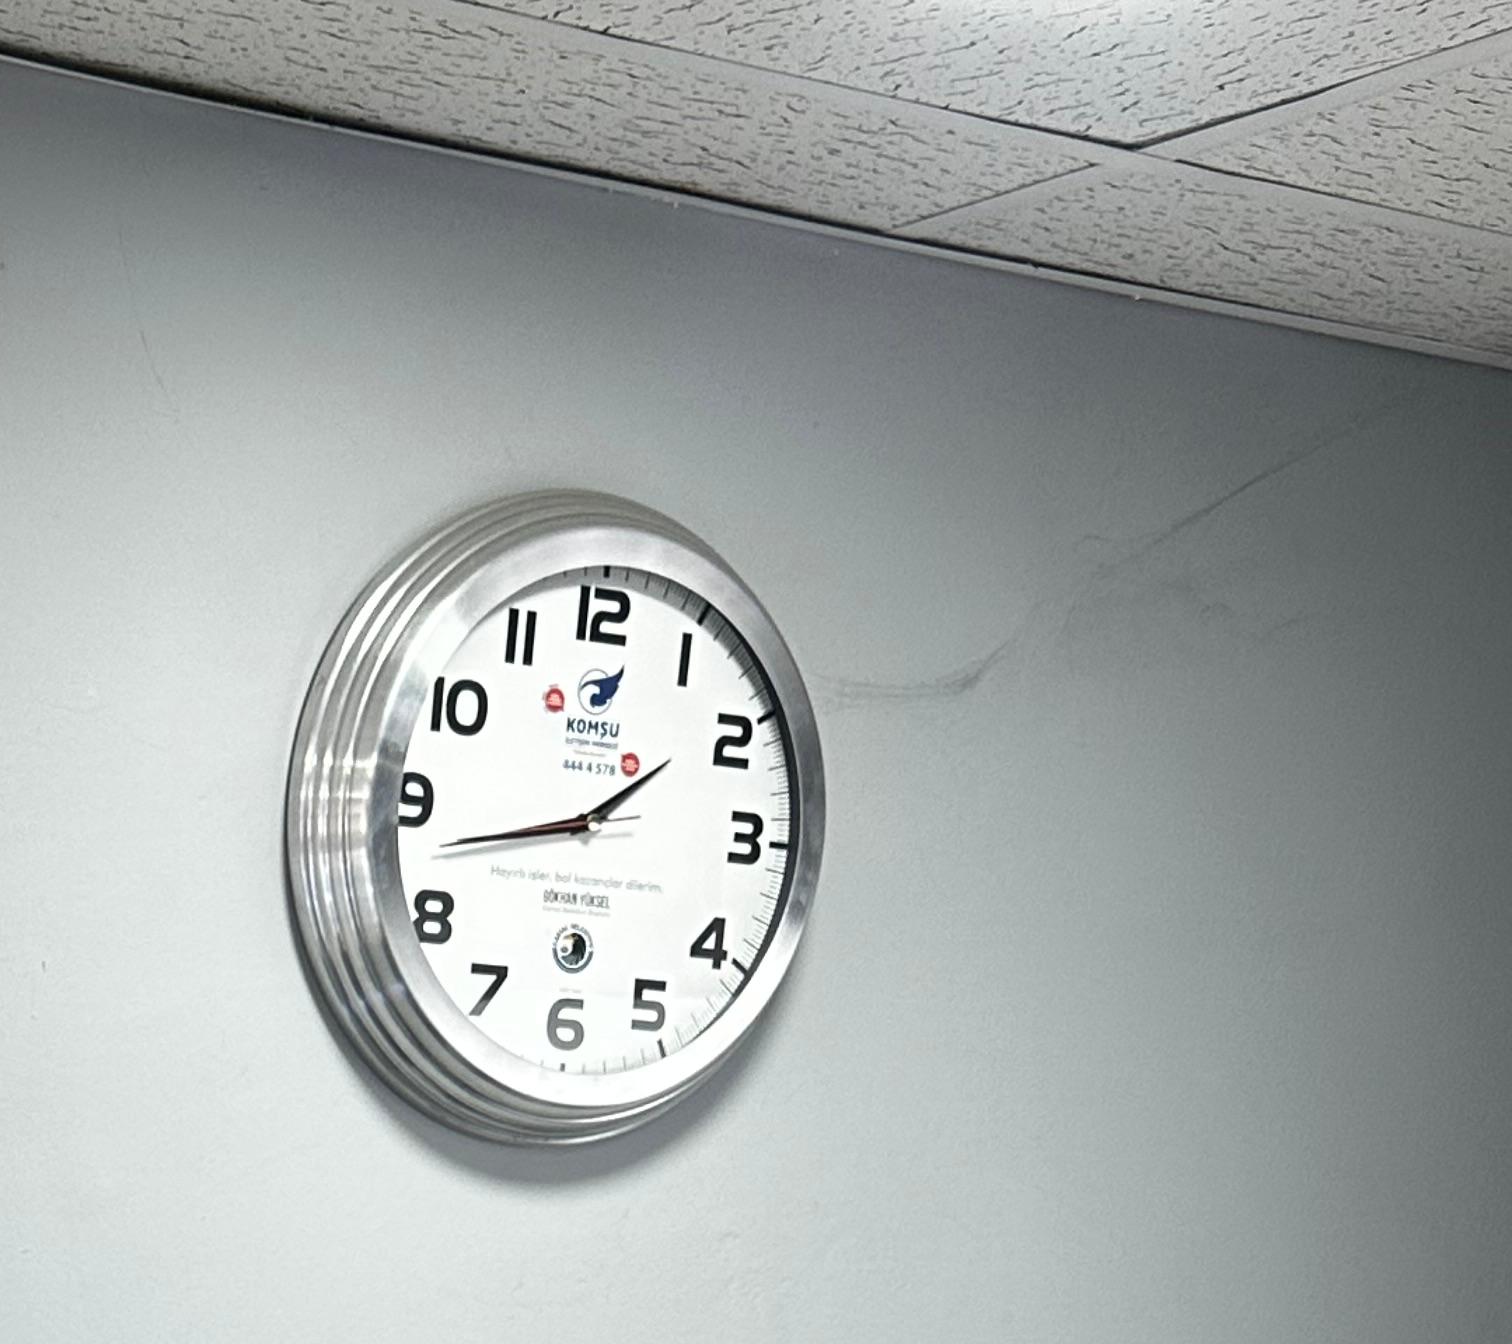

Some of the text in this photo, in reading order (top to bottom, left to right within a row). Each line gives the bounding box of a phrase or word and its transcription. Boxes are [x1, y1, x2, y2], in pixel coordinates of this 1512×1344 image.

[504, 607, 537, 666] 11
[576, 584, 631, 646] 12
[677, 632, 693, 687] 1
[431, 676, 488, 735] 10
[566, 717, 620, 740] KOMŞU
[563, 759, 583, 771] 444
[595, 763, 616, 776] 578
[712, 712, 754, 770] 2
[398, 771, 434, 827] 9
[727, 810, 764, 865] 3
[555, 872, 571, 883] bol
[413, 889, 455, 945] 8
[690, 917, 728, 970] 4
[468, 963, 509, 1017] 7
[631, 978, 668, 1032] 5
[546, 998, 586, 1051] 6
